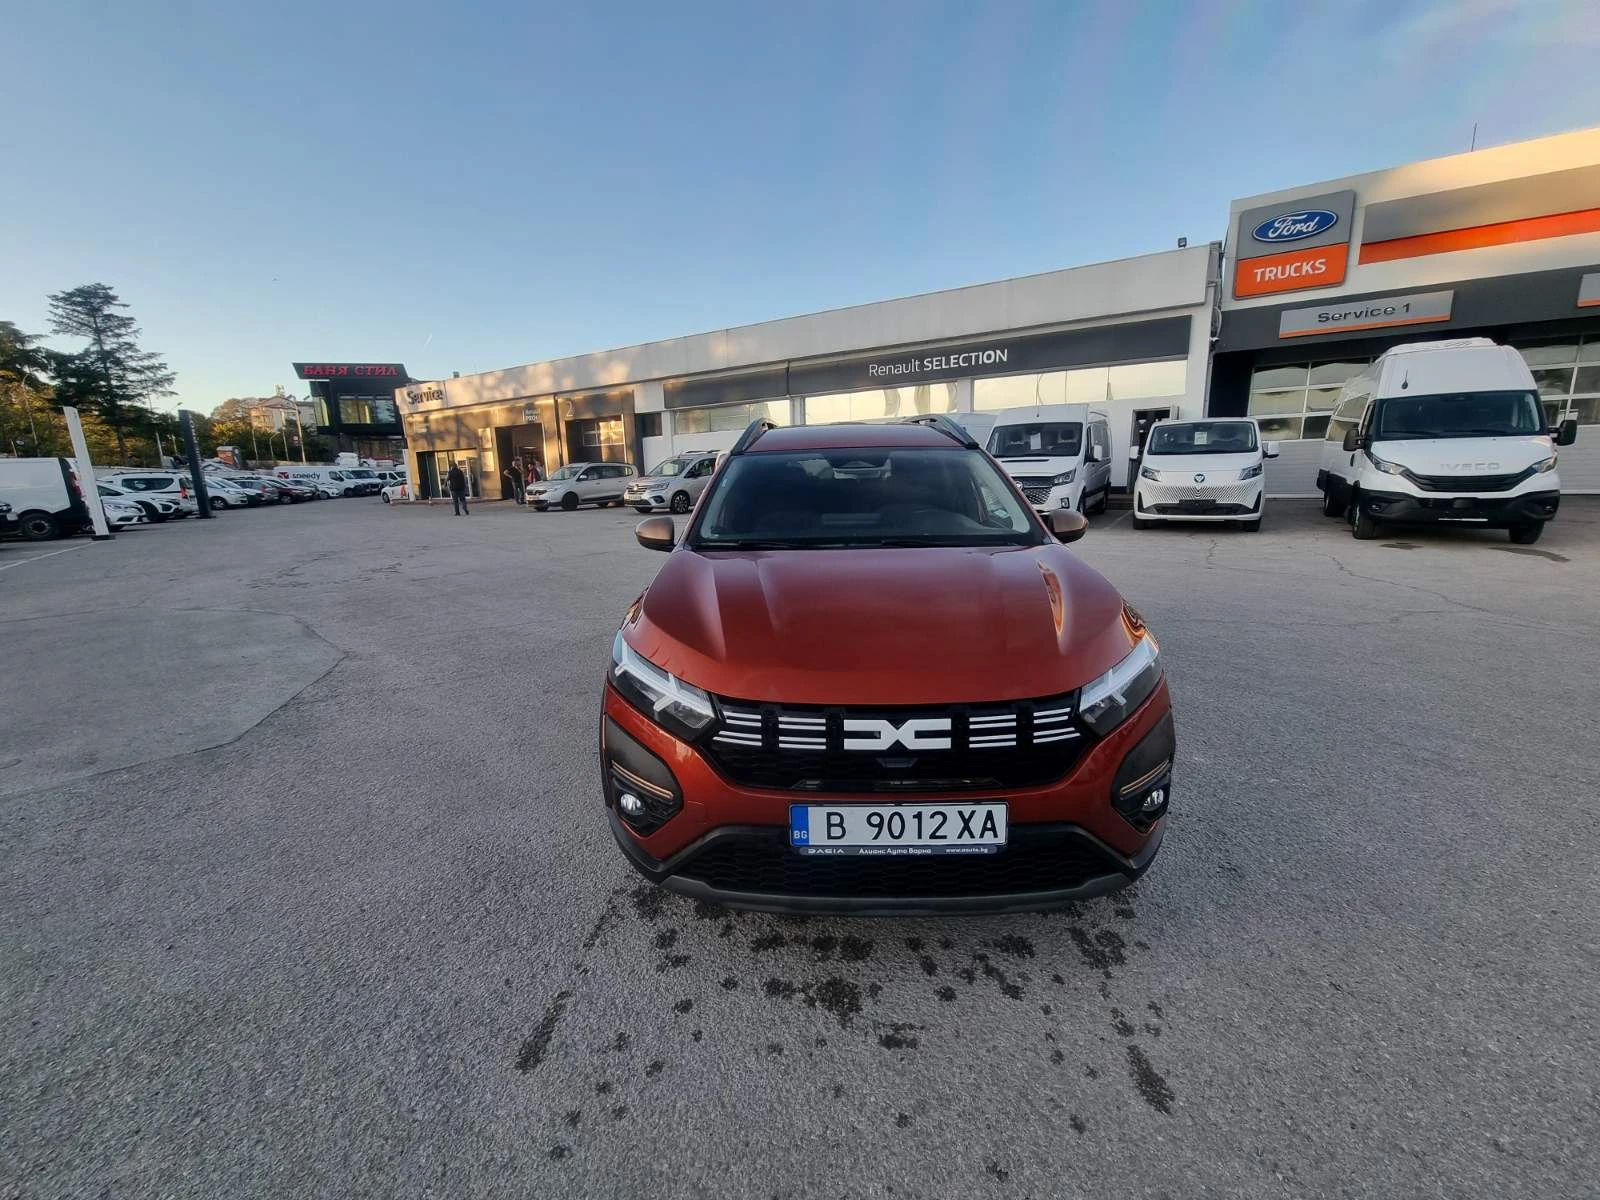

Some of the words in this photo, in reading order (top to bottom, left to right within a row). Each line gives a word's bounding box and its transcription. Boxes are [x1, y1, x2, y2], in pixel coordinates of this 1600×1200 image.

[1267, 210, 1319, 239] Ford
[1254, 258, 1327, 283] TRUCKS
[1317, 304, 1397, 323] Service
[1401, 303, 1411, 316] 1
[303, 365, 349, 376] БАНЯ
[354, 365, 398, 376] СТИЛ
[868, 358, 920, 377] Renault
[923, 348, 1008, 372] SELECTION
[407, 387, 444, 405] Service
[565, 400, 574, 417] 2
[1439, 462, 1501, 471] IVECO
[292, 471, 320, 480] speedy
[793, 830, 808, 839] BG
